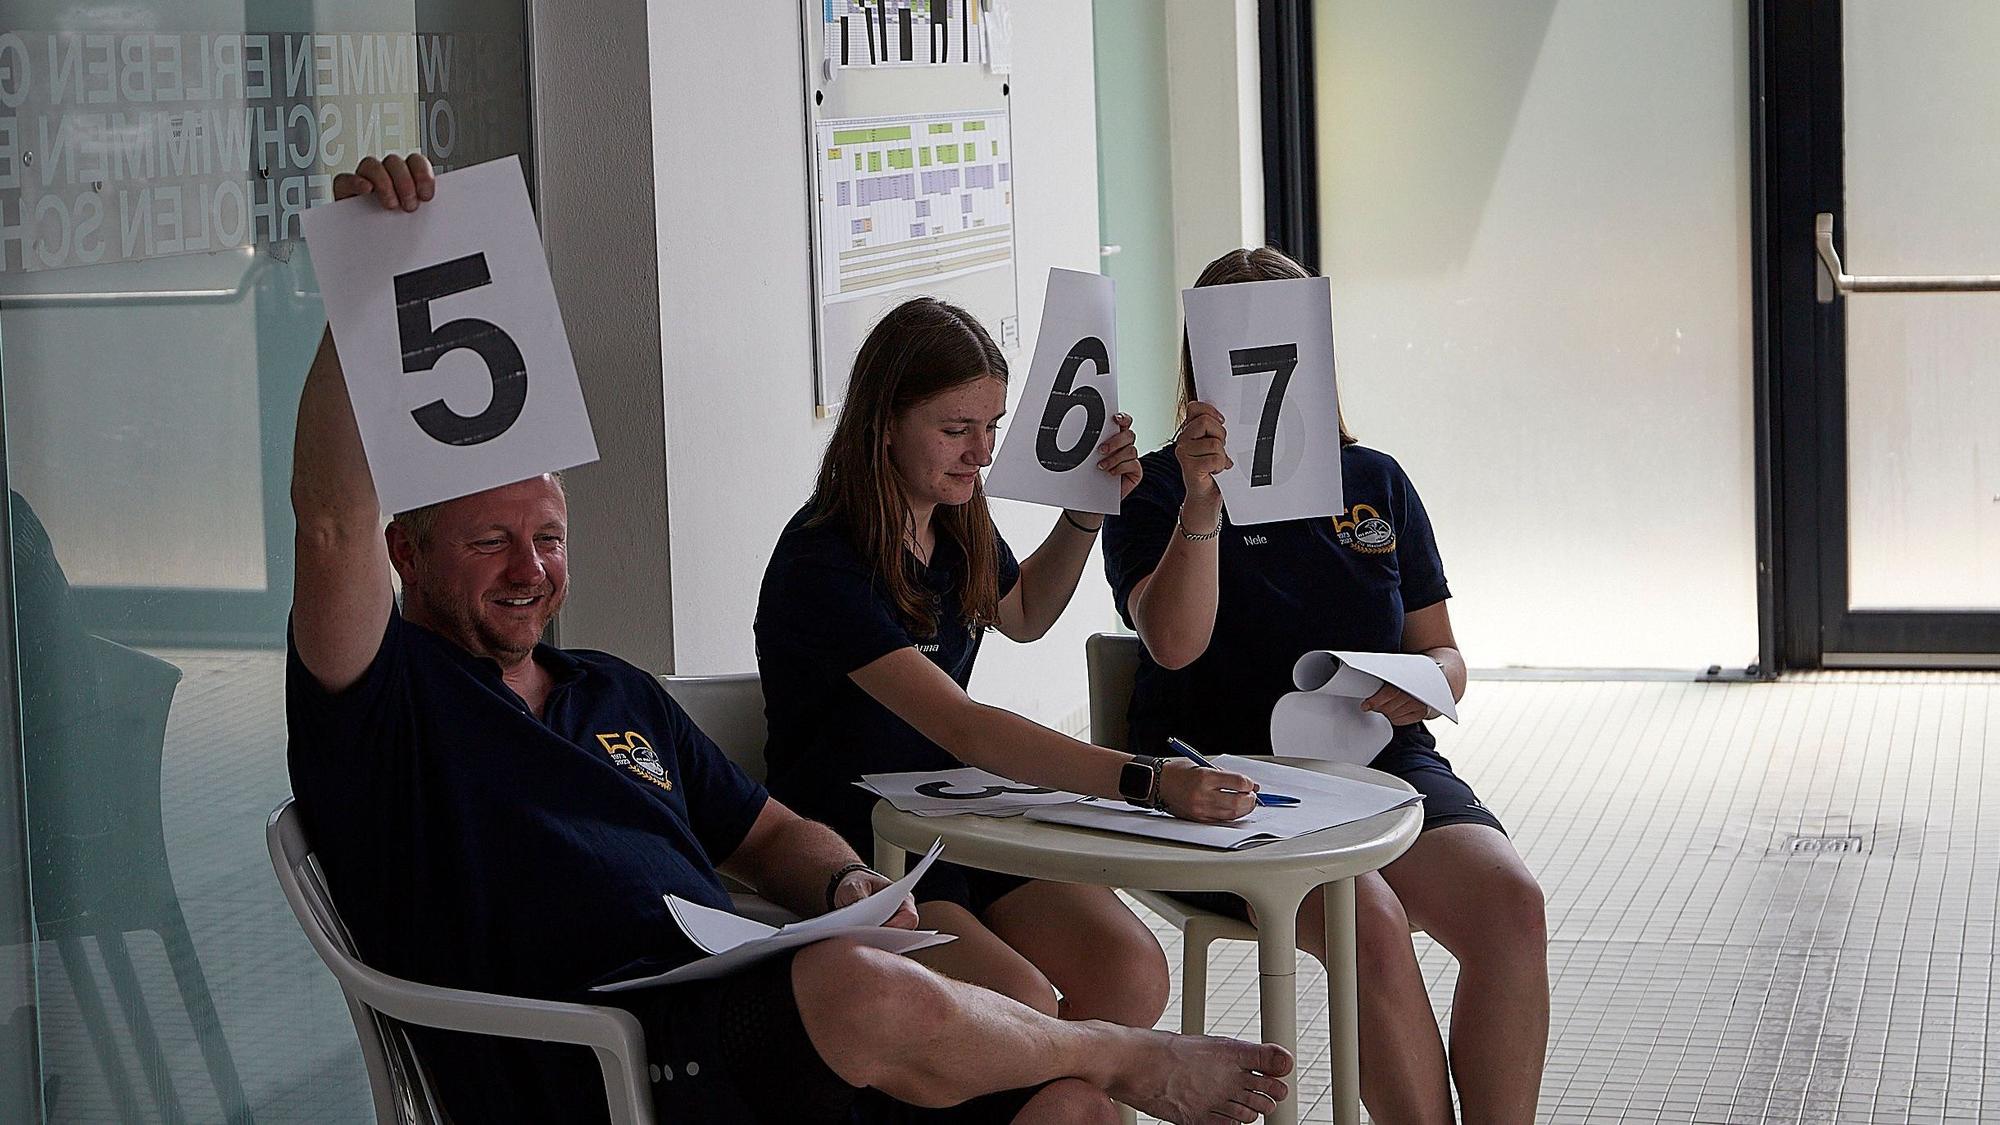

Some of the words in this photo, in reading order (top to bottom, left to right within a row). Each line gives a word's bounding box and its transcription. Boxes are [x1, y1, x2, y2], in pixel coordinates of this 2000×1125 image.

[393, 251, 528, 446] 5
[1035, 336, 1111, 472] 6
[1229, 343, 1298, 487] 7
[1243, 534, 1268, 546] Nele
